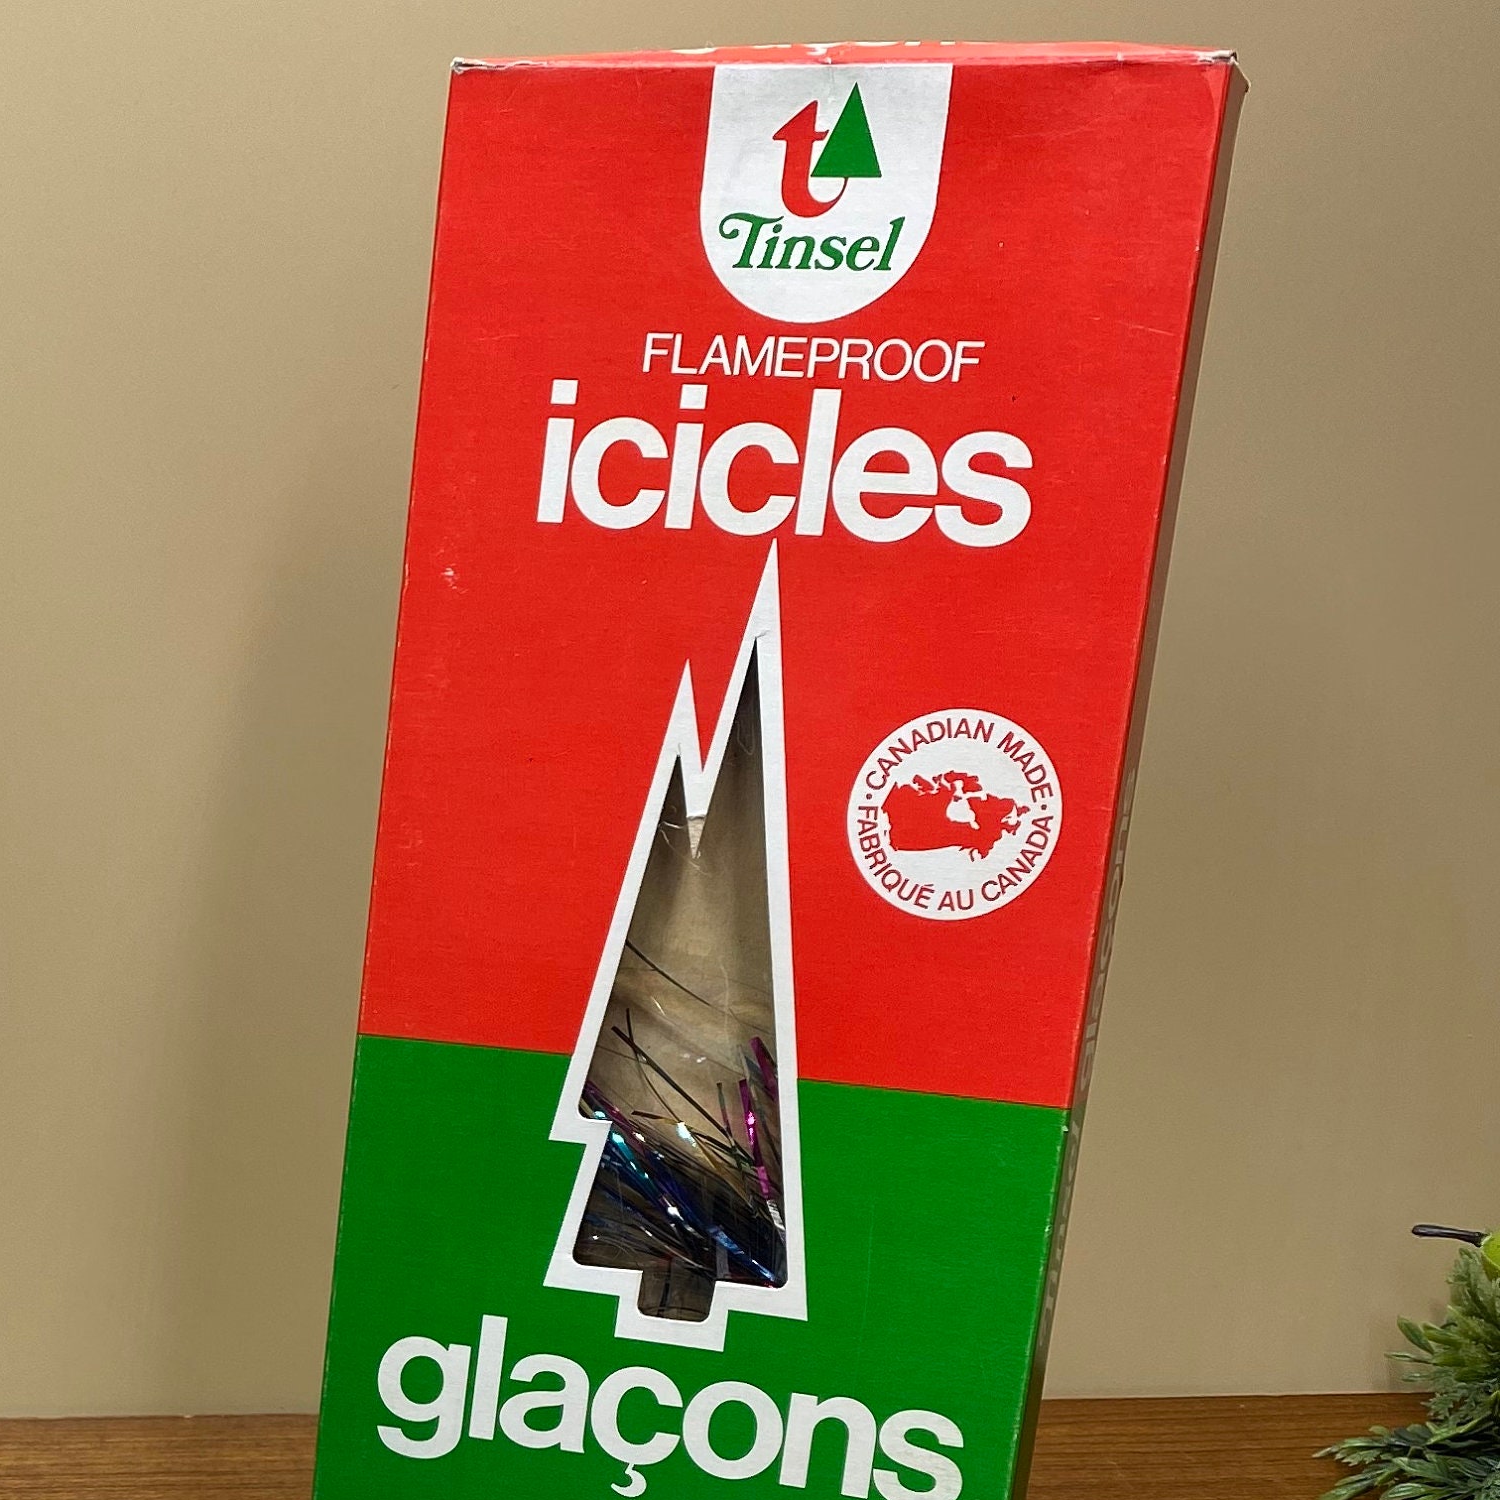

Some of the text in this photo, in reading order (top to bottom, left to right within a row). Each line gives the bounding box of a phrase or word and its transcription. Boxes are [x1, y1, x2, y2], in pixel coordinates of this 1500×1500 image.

[719, 212, 905, 272] Tinsel
[642, 333, 986, 383] FLAMEPROOF
[536, 379, 1034, 547] icicles
[865, 717, 1054, 803] CANADIAN MADE
[856, 804, 1054, 912] FABRIQUÉ AU CANADA
